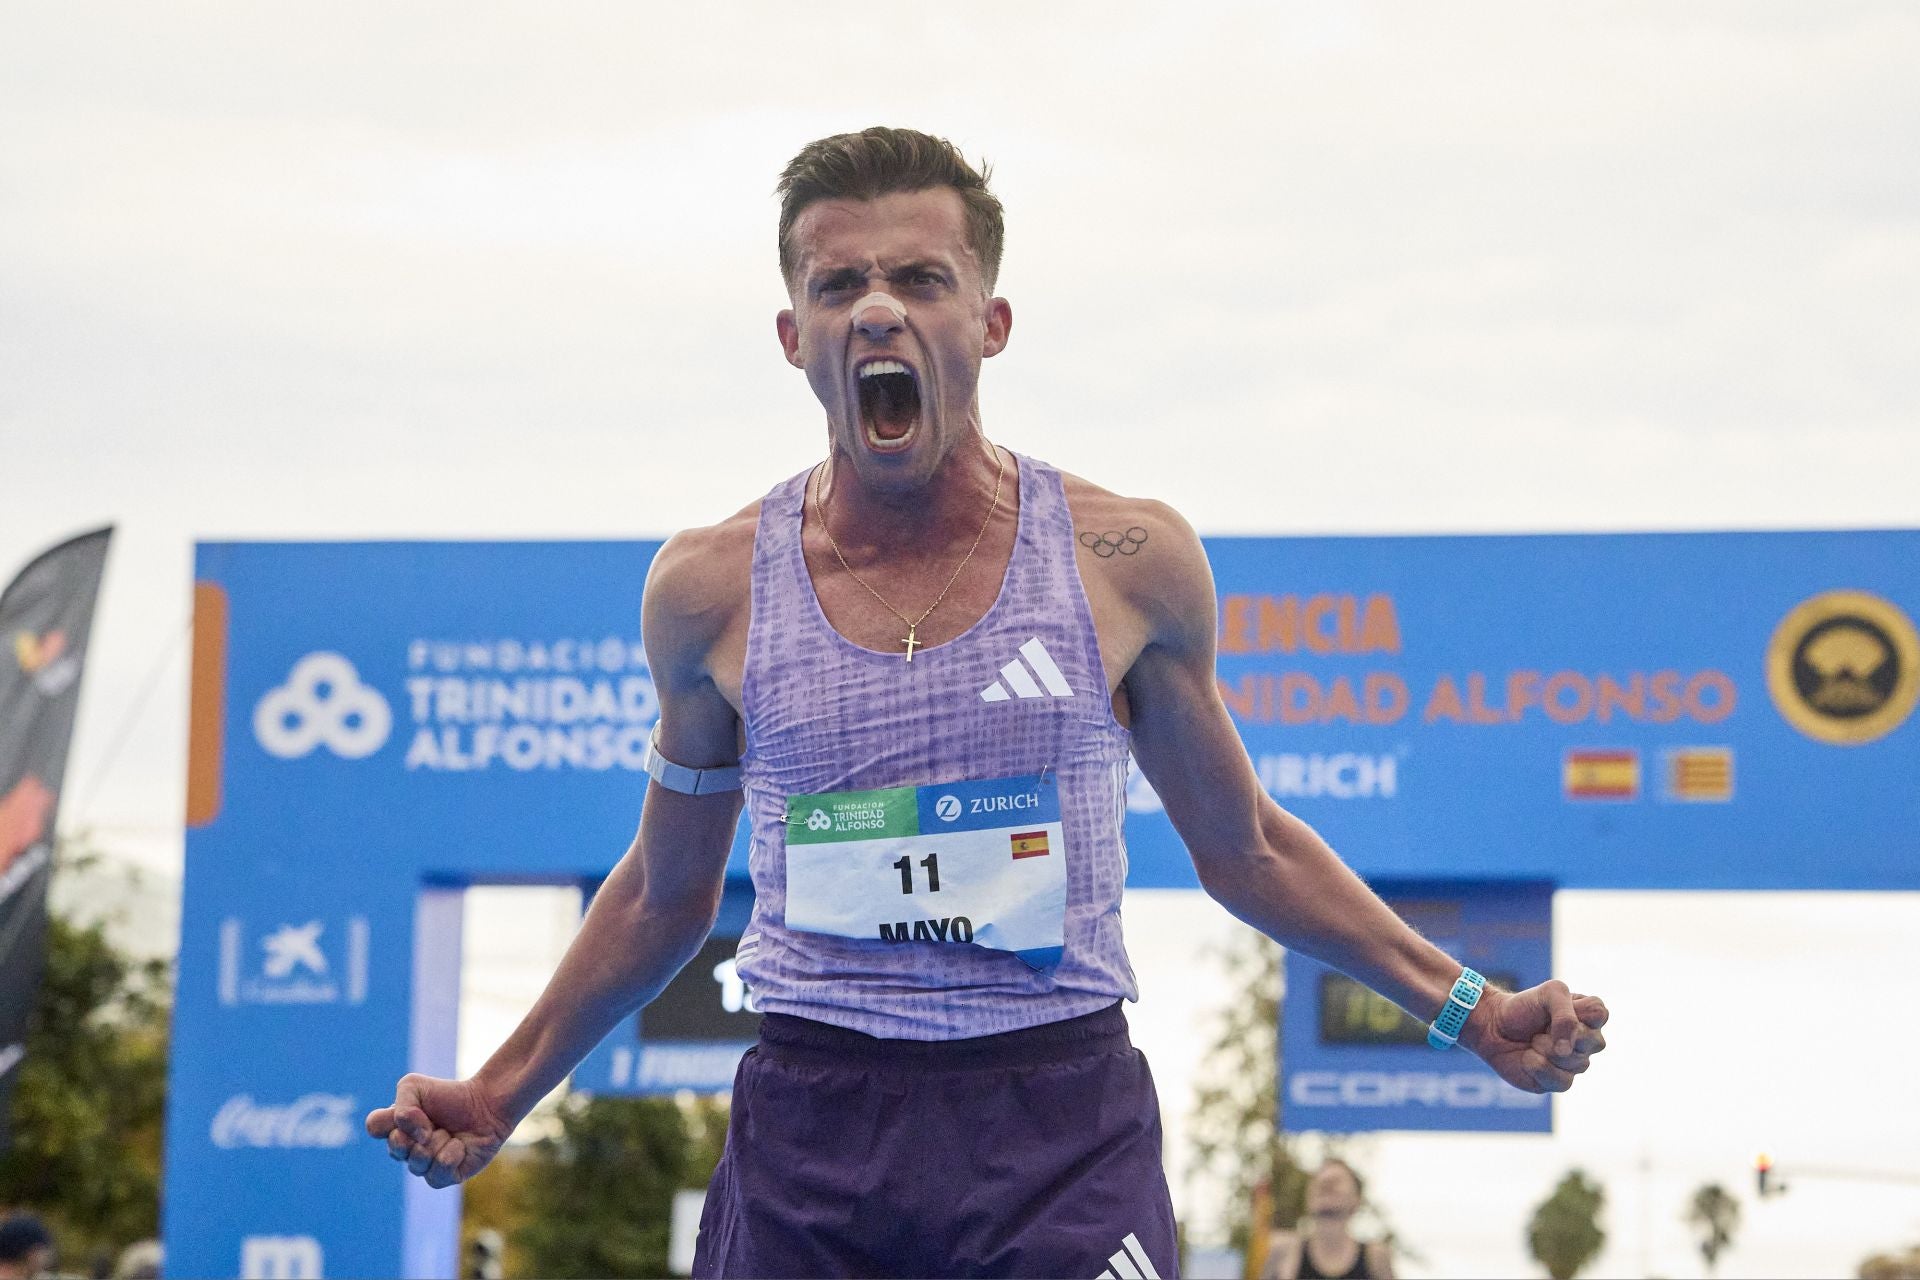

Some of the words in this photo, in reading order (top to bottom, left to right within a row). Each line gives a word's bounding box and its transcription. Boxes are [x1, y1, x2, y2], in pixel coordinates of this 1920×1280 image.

[1217, 593, 1402, 654] ENCIA
[406, 675, 660, 724] TRINIDAD
[1423, 669, 1737, 726] ALFONSO
[403, 724, 653, 771] ALFONSO
[833, 809, 885, 822] TRINIDAD
[970, 793, 1039, 814] ZURICH
[835, 819, 885, 832] ALFONSO
[893, 853, 940, 895] 11
[879, 916, 973, 944] MAYO
